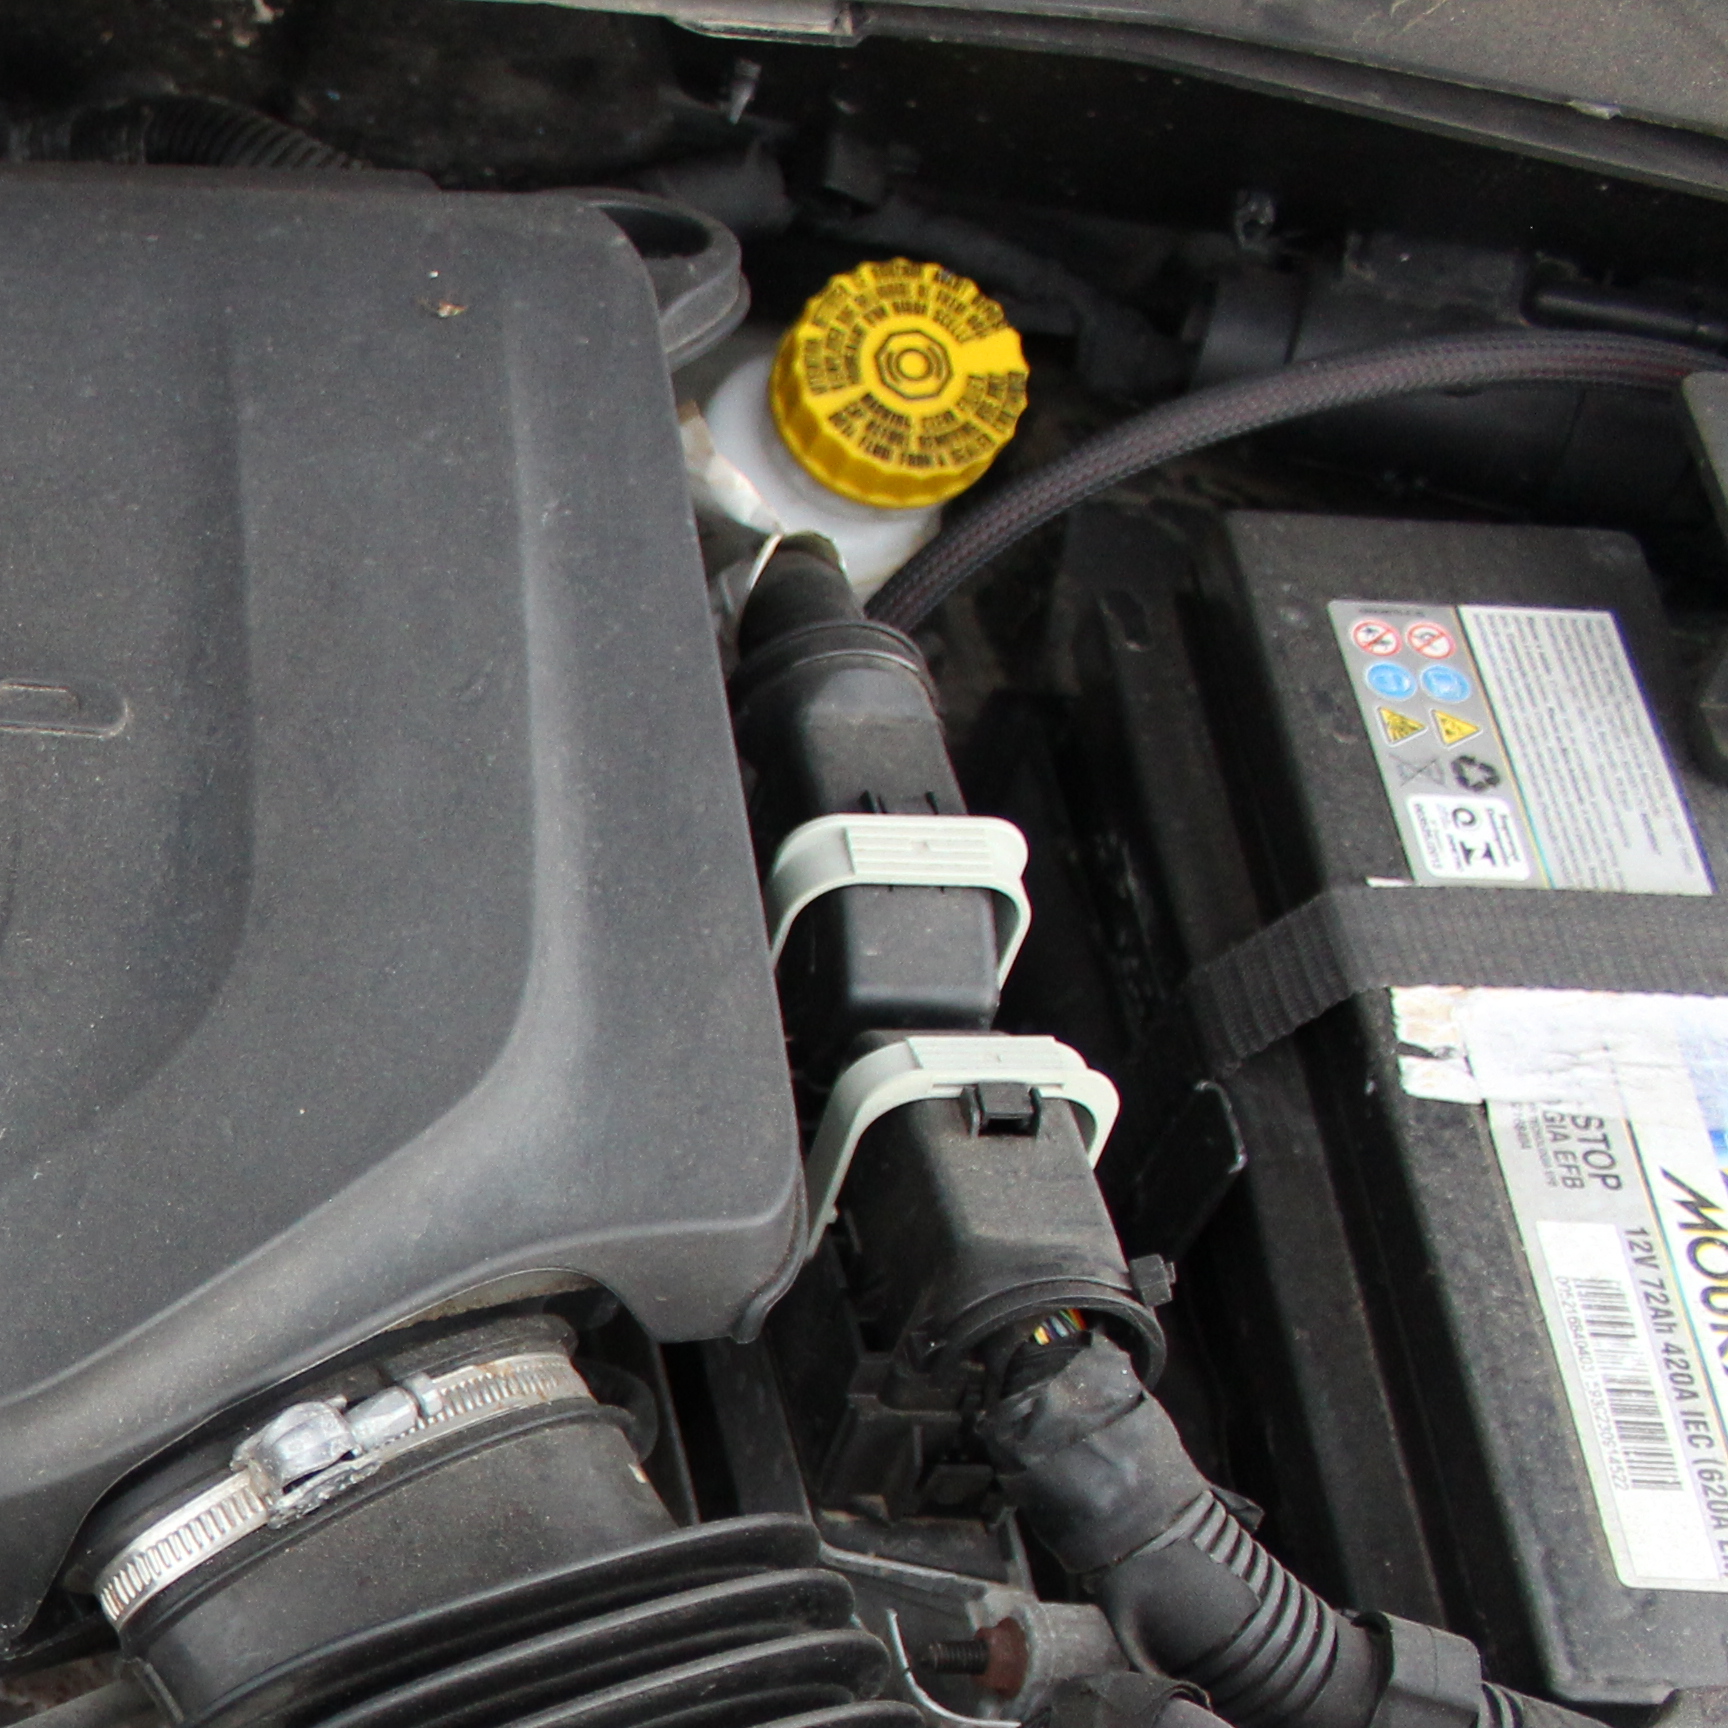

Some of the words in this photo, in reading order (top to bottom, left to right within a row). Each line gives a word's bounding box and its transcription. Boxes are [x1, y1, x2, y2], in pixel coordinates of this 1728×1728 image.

[1552, 1150, 1586, 1189] EFB
[1625, 1226, 1661, 1271] 12V
[1640, 1276, 1679, 1335] 72Ah
[1661, 1341, 1699, 1404] 420A
[1679, 1410, 1715, 1449] IEC
